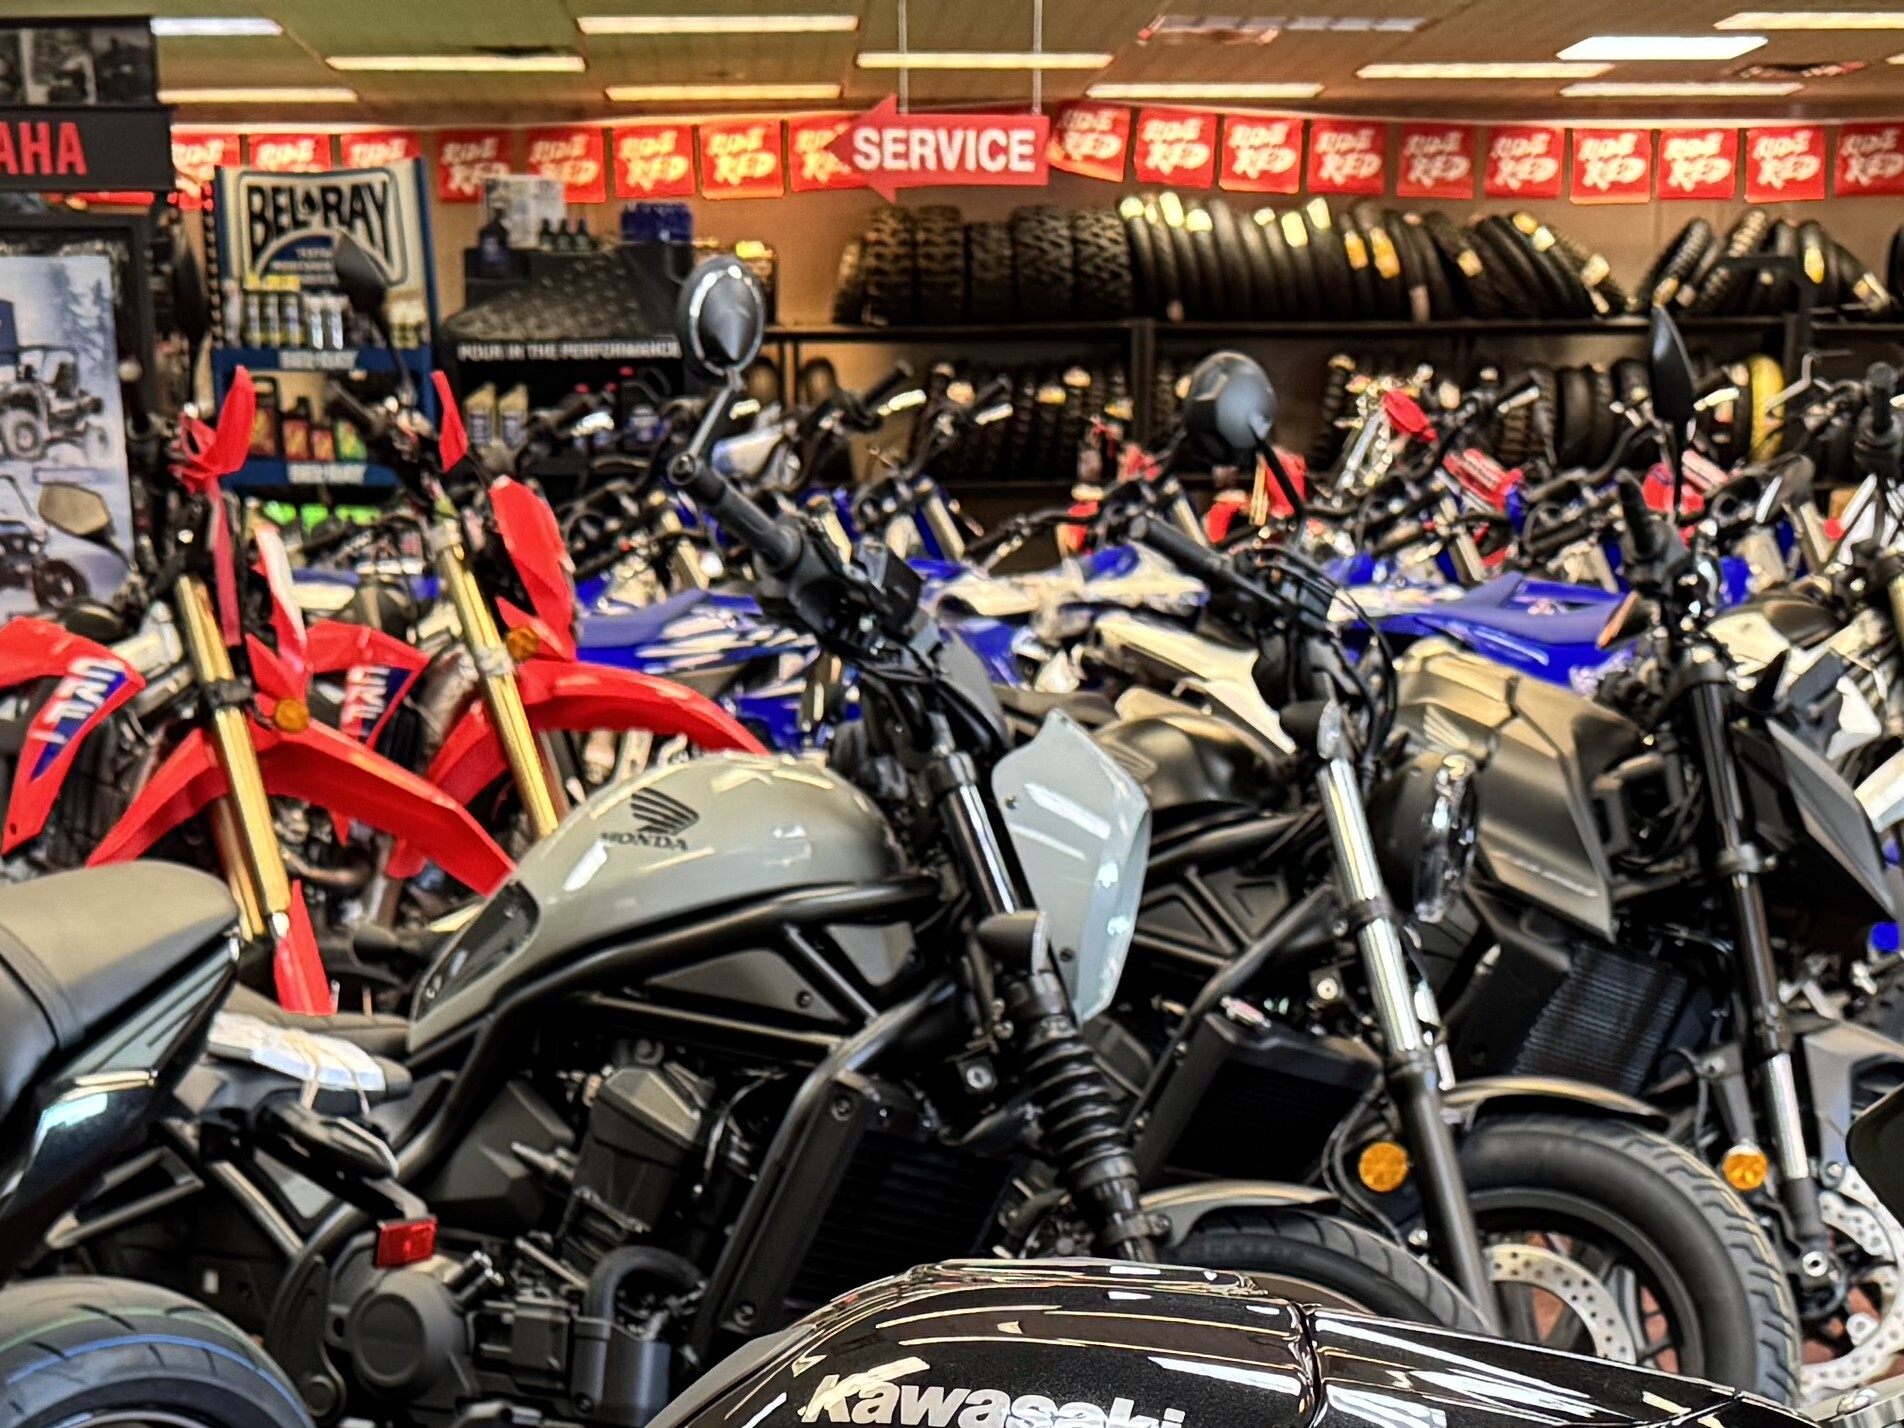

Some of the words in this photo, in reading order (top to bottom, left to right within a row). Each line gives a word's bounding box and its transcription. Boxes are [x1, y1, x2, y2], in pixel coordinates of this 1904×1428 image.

[1062, 110, 1114, 130] RIDE
[1142, 118, 1203, 143] RIDE
[529, 134, 589, 163] RIDE
[619, 130, 678, 159] RIDE
[707, 127, 765, 155] RIDE
[853, 128, 1036, 172] SERVICE
[1064, 132, 1122, 162] RED
[1229, 123, 1291, 148] RIDE
[1316, 129, 1376, 153] RIDE
[1404, 130, 1463, 157] RIDE
[1491, 133, 1552, 158] RIDE
[1578, 132, 1638, 160] RIDE
[1663, 131, 1724, 160] RIDE
[1752, 129, 1812, 160] RIDE
[1840, 128, 1899, 156] RIDE
[442, 137, 499, 164] RIDE
[1146, 141, 1210, 174] RED
[1232, 147, 1297, 179] RED
[625, 155, 689, 192] RED
[714, 152, 776, 185] RED
[1319, 152, 1382, 185] RED
[1408, 154, 1471, 188] RED
[1496, 157, 1559, 190] RED
[1582, 157, 1647, 190] RED
[1668, 156, 1731, 191] RED
[1757, 155, 1820, 189] RED
[602, 831, 688, 853] HONDA
